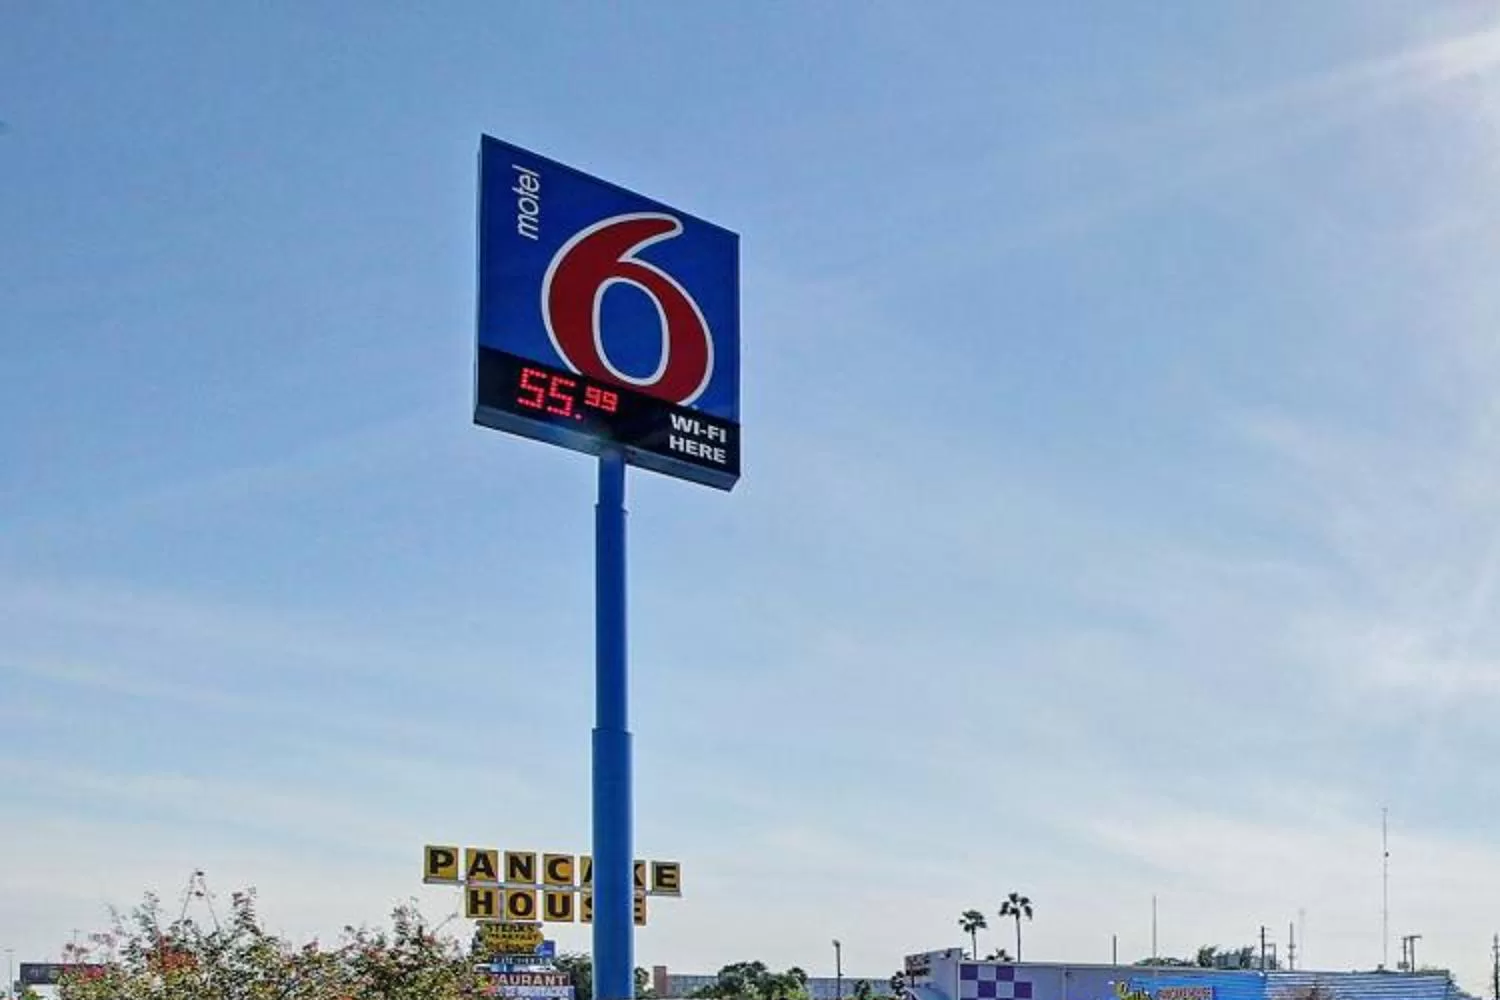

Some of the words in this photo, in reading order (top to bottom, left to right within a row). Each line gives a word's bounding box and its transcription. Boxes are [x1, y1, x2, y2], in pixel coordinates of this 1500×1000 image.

[511, 165, 540, 240] motel
[541, 211, 715, 407] 6
[669, 412, 727, 443] WI-FI
[669, 434, 727, 464] HERE
